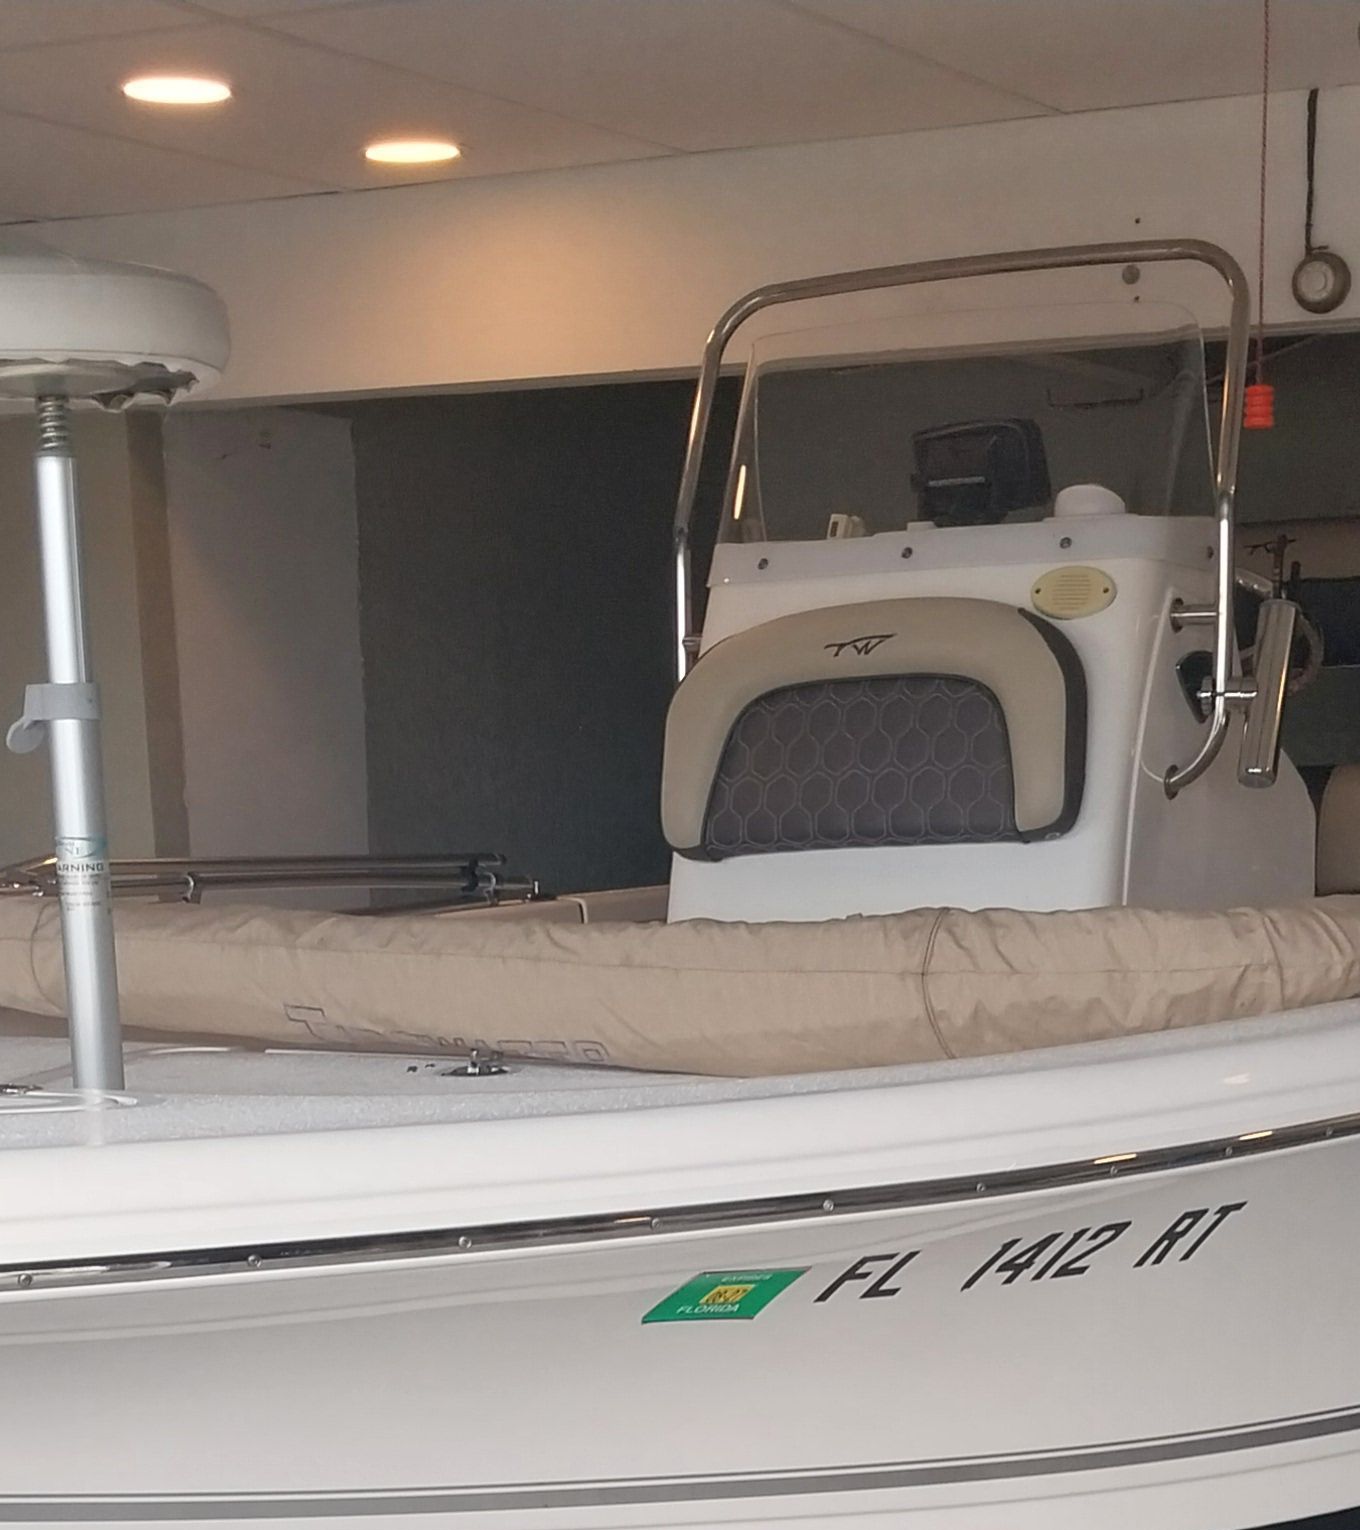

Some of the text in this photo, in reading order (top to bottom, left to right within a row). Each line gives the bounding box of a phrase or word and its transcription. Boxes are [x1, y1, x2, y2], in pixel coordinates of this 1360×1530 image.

[813, 1201, 1248, 1304] FL 1412 RT
[677, 1304, 740, 1314] FLORIDA
